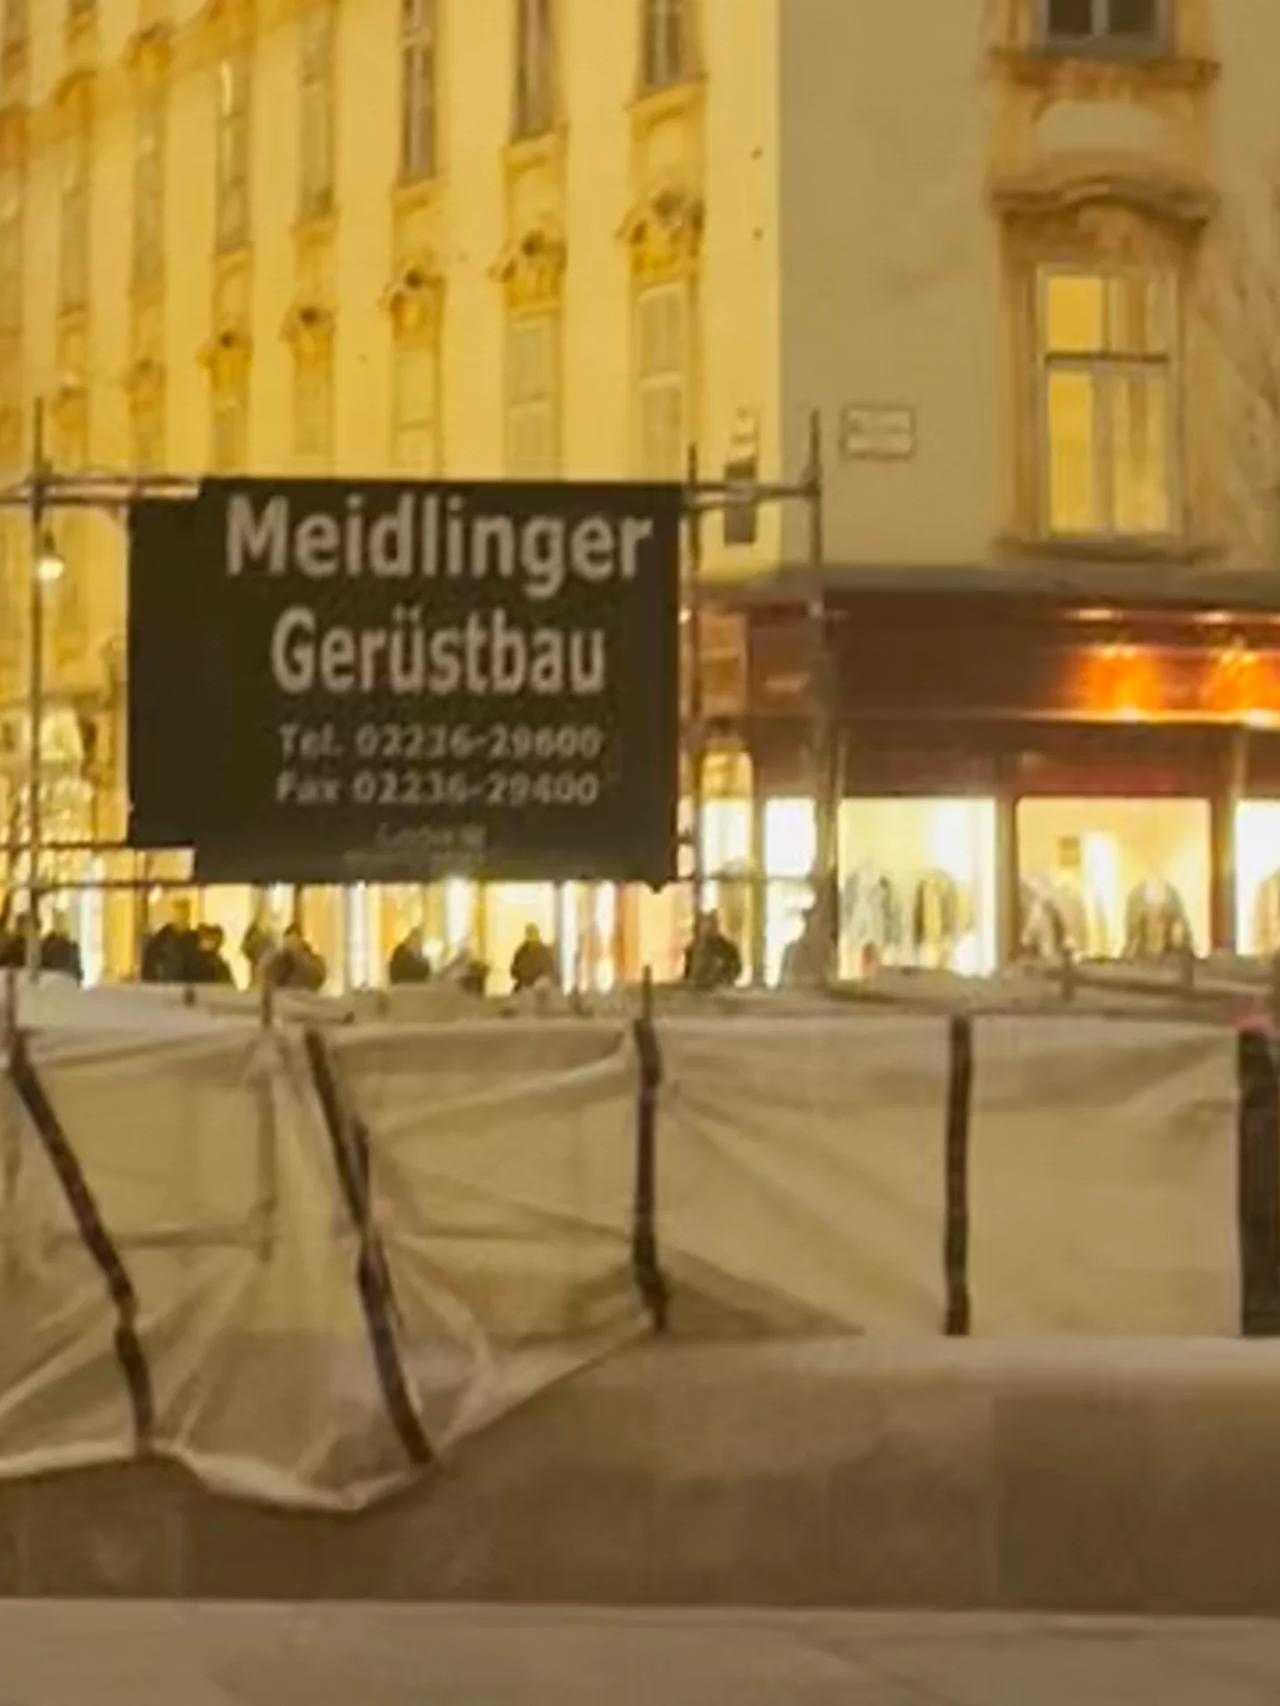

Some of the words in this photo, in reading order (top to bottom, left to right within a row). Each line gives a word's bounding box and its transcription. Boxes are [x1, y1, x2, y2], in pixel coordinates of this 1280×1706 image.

[226, 492, 652, 600] Meidlinger
[271, 606, 605, 695] Gerüstbau
[278, 721, 344, 760] Tel.
[275, 768, 342, 804] Fax
